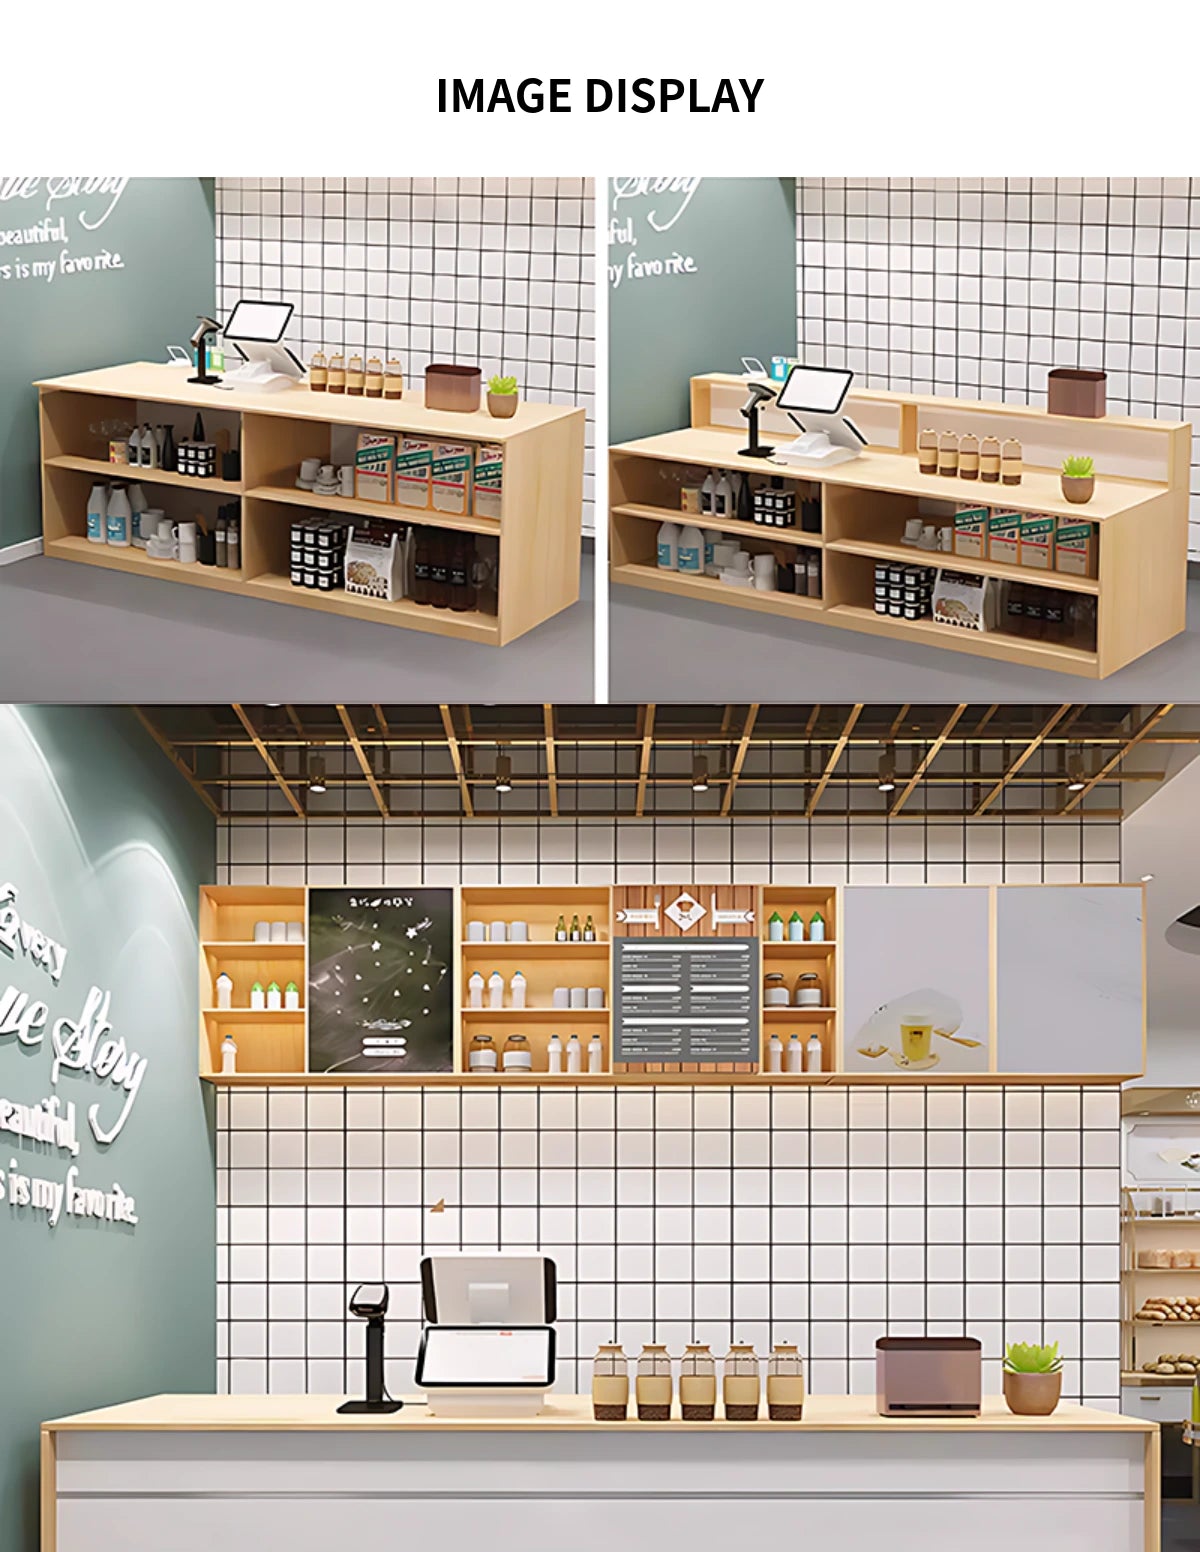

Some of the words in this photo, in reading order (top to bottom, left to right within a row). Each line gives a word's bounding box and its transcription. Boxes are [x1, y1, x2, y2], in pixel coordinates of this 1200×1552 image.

[15, 257, 30, 279] is
[32, 260, 56, 283] my
[52, 985, 148, 1143] Story
[8, 1158, 31, 1206] is
[31, 1178, 64, 1227] my
